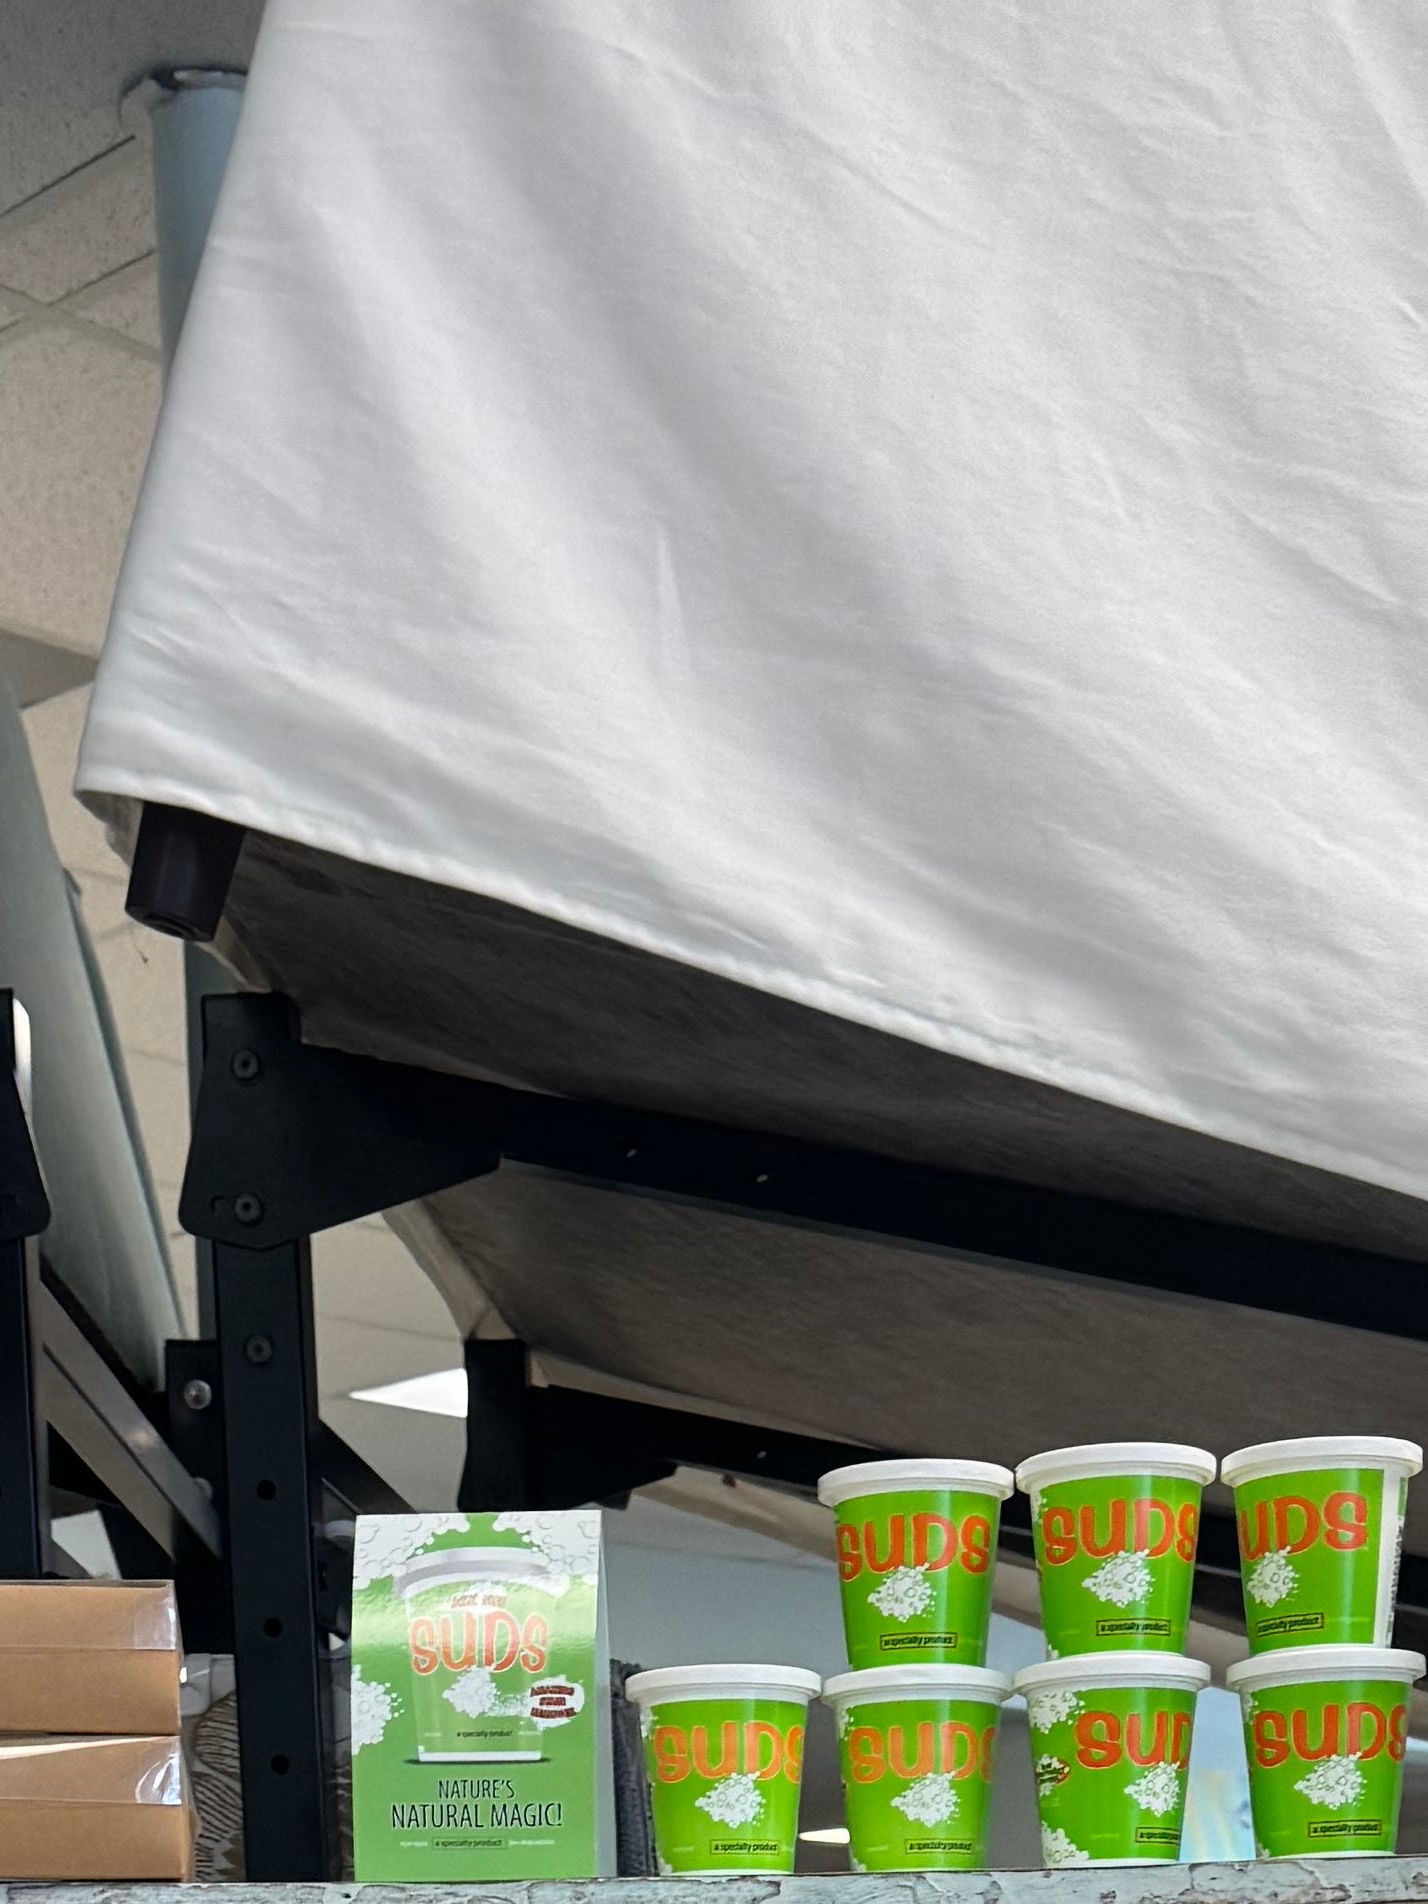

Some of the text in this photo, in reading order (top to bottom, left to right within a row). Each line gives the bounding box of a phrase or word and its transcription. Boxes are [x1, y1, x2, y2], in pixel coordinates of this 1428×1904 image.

[836, 1513, 991, 1582] SUDS
[1041, 1498, 1198, 1567] SUDS
[410, 1608, 549, 1676] SUDS
[392, 1802, 563, 1829] NATURAL MAGIC!
[438, 1779, 515, 1799] NATURE'S
